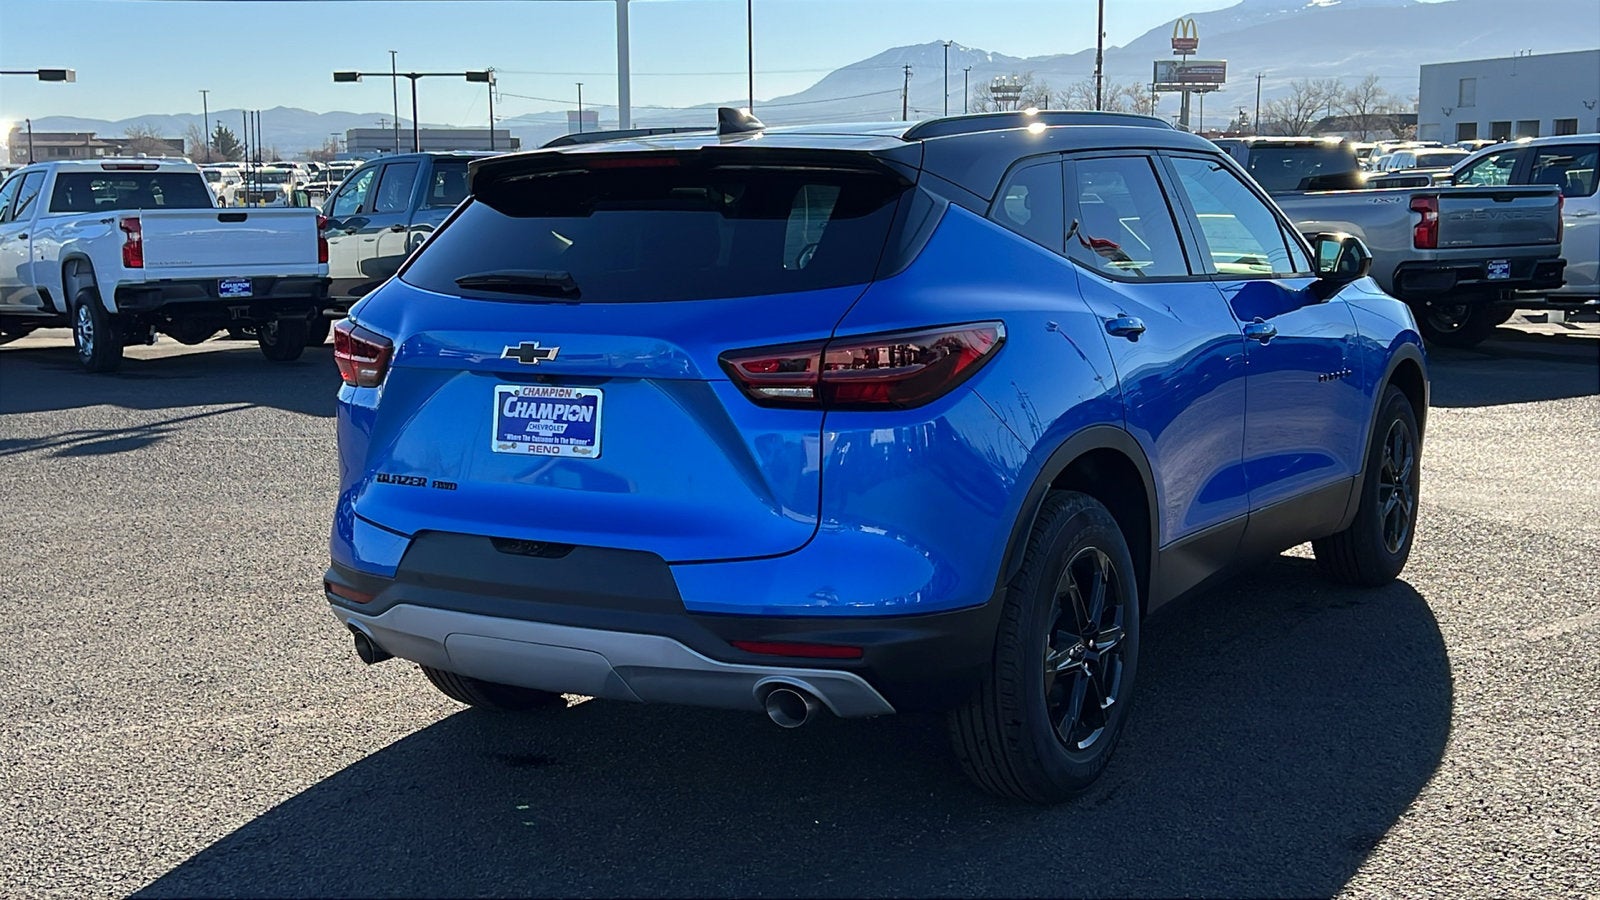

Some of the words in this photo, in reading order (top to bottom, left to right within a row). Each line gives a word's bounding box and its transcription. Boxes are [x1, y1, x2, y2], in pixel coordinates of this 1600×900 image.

[523, 387, 573, 398] CHAMPION
[503, 396, 594, 423] CHAMPION
[528, 422, 565, 431] CHEVROLET
[522, 434, 531, 442] The
[531, 435, 554, 444] Customer
[560, 437, 569, 445] The
[527, 445, 560, 454] RENO
[376, 473, 428, 488] BLAZER
